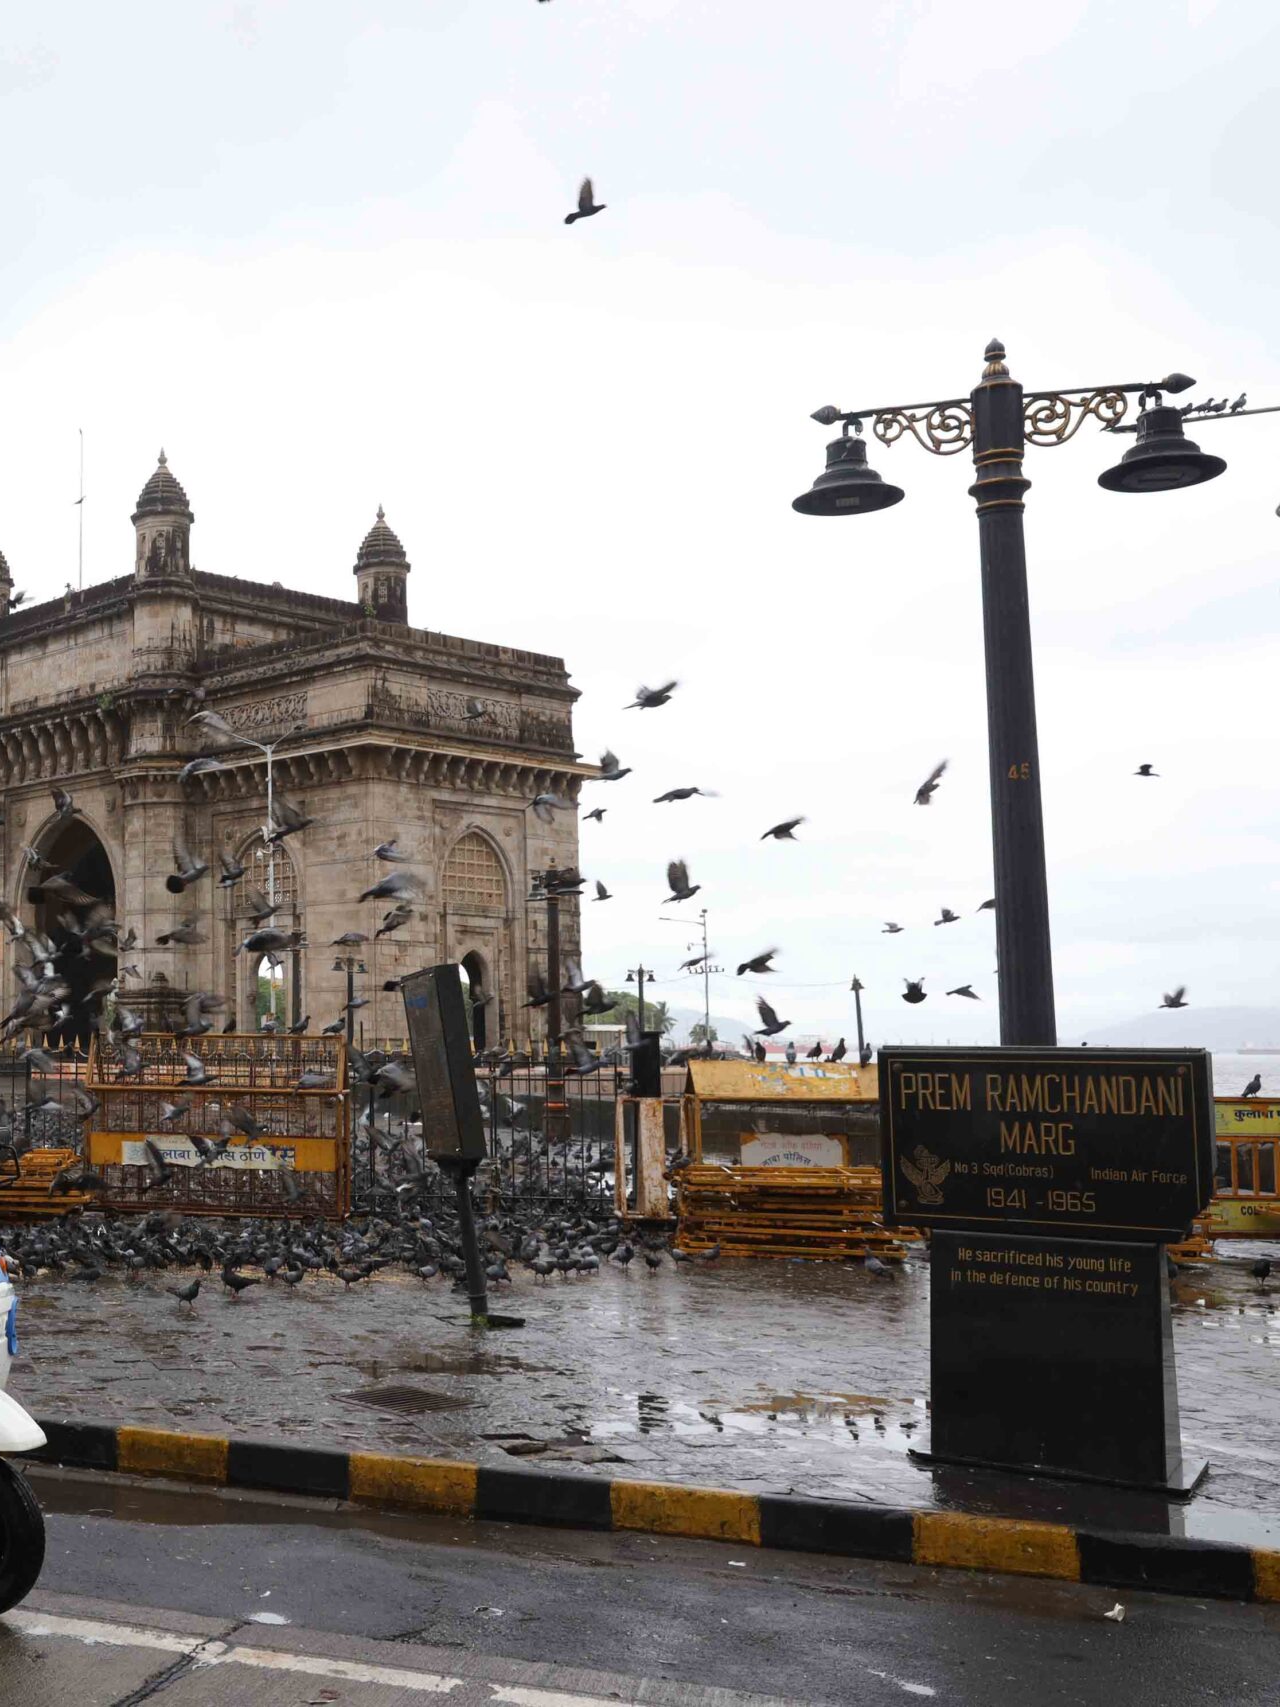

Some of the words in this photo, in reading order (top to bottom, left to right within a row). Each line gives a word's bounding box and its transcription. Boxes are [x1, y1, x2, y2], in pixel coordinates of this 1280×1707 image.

[900, 1073, 972, 1112] PREM
[985, 1073, 1185, 1117] RAMCHANDANI
[1000, 1121, 1076, 1156] MARG
[954, 1161, 969, 1174] No
[970, 1161, 978, 1174] 3
[1091, 1168, 1127, 1181] Indian
[1131, 1169, 1149, 1183] Air
[1152, 1170, 1188, 1184] Force
[987, 1187, 1026, 1210] 1941
[1048, 1190, 1096, 1212] 1965
[958, 1247, 973, 1261] He
[975, 1249, 1042, 1266] sacrificed
[1046, 1253, 1064, 1268] his
[1067, 1256, 1105, 1273] young
[1109, 1257, 1132, 1273] life
[951, 1269, 962, 1282] in
[967, 1269, 986, 1284] the
[990, 1271, 1040, 1288] defence
[1044, 1275, 1059, 1289] of
[1063, 1277, 1082, 1292] his
[1086, 1280, 1139, 1297] country
